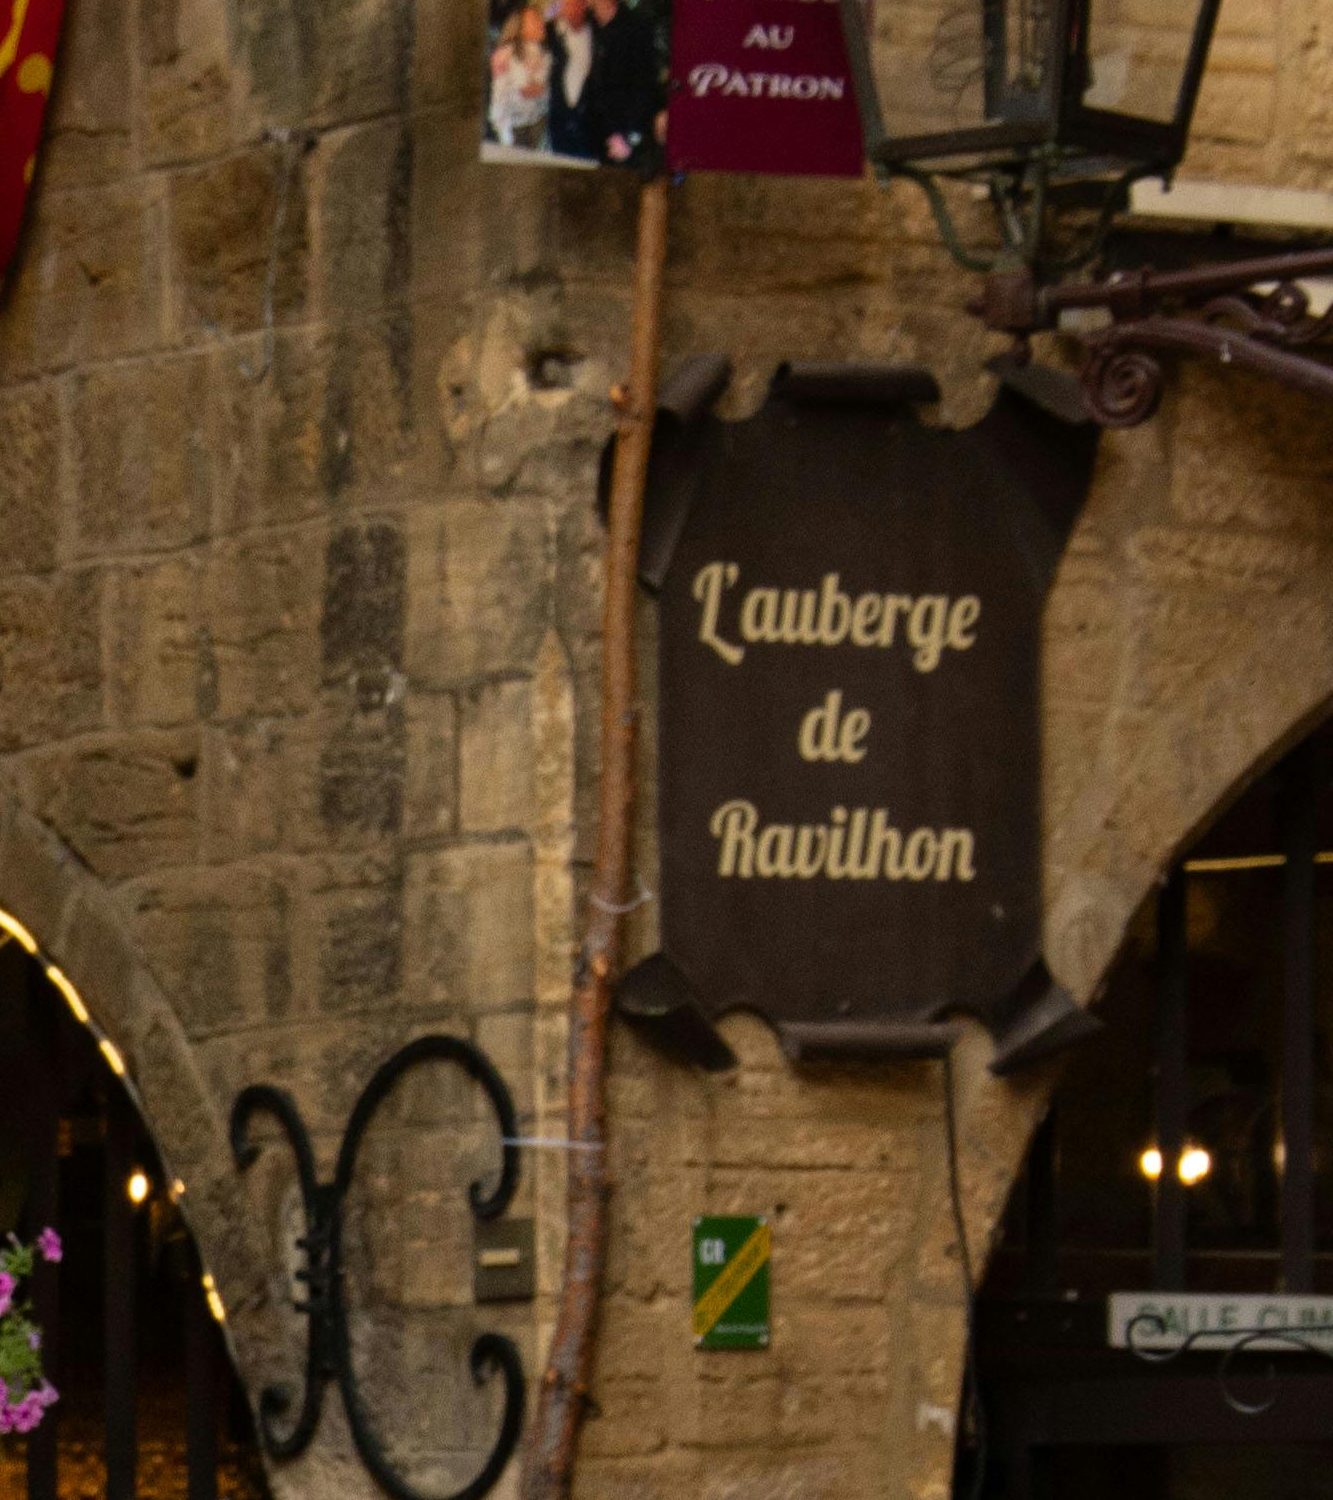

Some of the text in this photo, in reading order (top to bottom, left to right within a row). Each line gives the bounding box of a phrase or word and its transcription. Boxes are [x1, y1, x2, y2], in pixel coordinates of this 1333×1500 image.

[742, 23, 795, 50] AU
[688, 63, 845, 100] PATRON
[692, 560, 981, 674] L'auberge
[796, 689, 872, 764] de
[709, 798, 977, 882] Ravilhon
